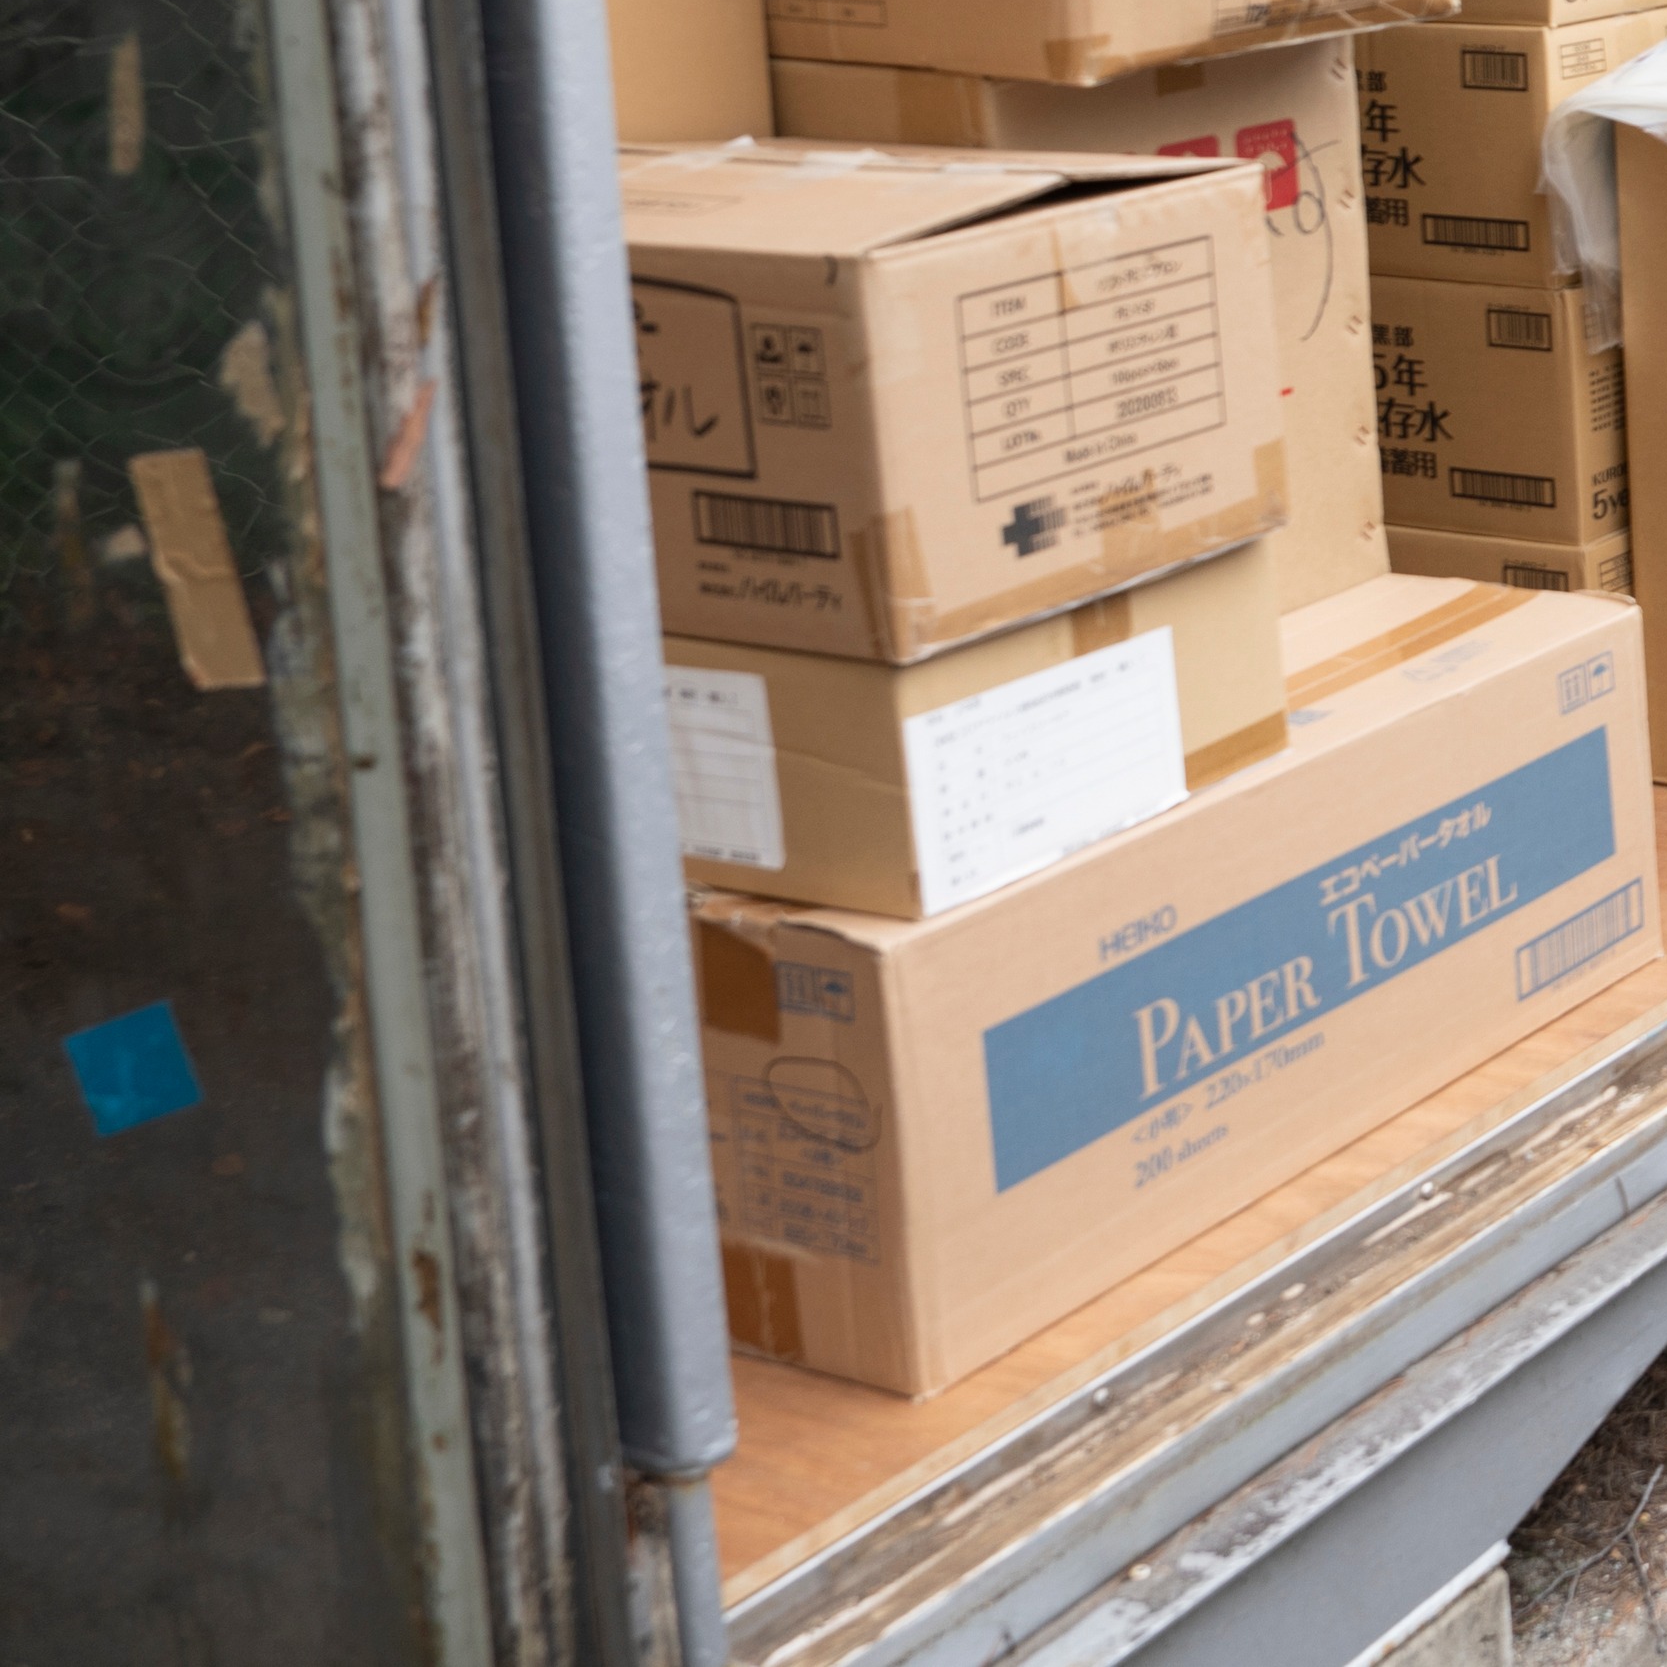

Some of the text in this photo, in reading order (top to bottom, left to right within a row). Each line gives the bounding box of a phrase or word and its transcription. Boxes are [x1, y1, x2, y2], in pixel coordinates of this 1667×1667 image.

[1319, 800, 1493, 907] エコペーパータオル
[1098, 902, 1179, 963] HEIKO
[1131, 853, 1520, 1102] PAPER TOWEL
[1133, 1121, 1230, 1191] 200 sheets
